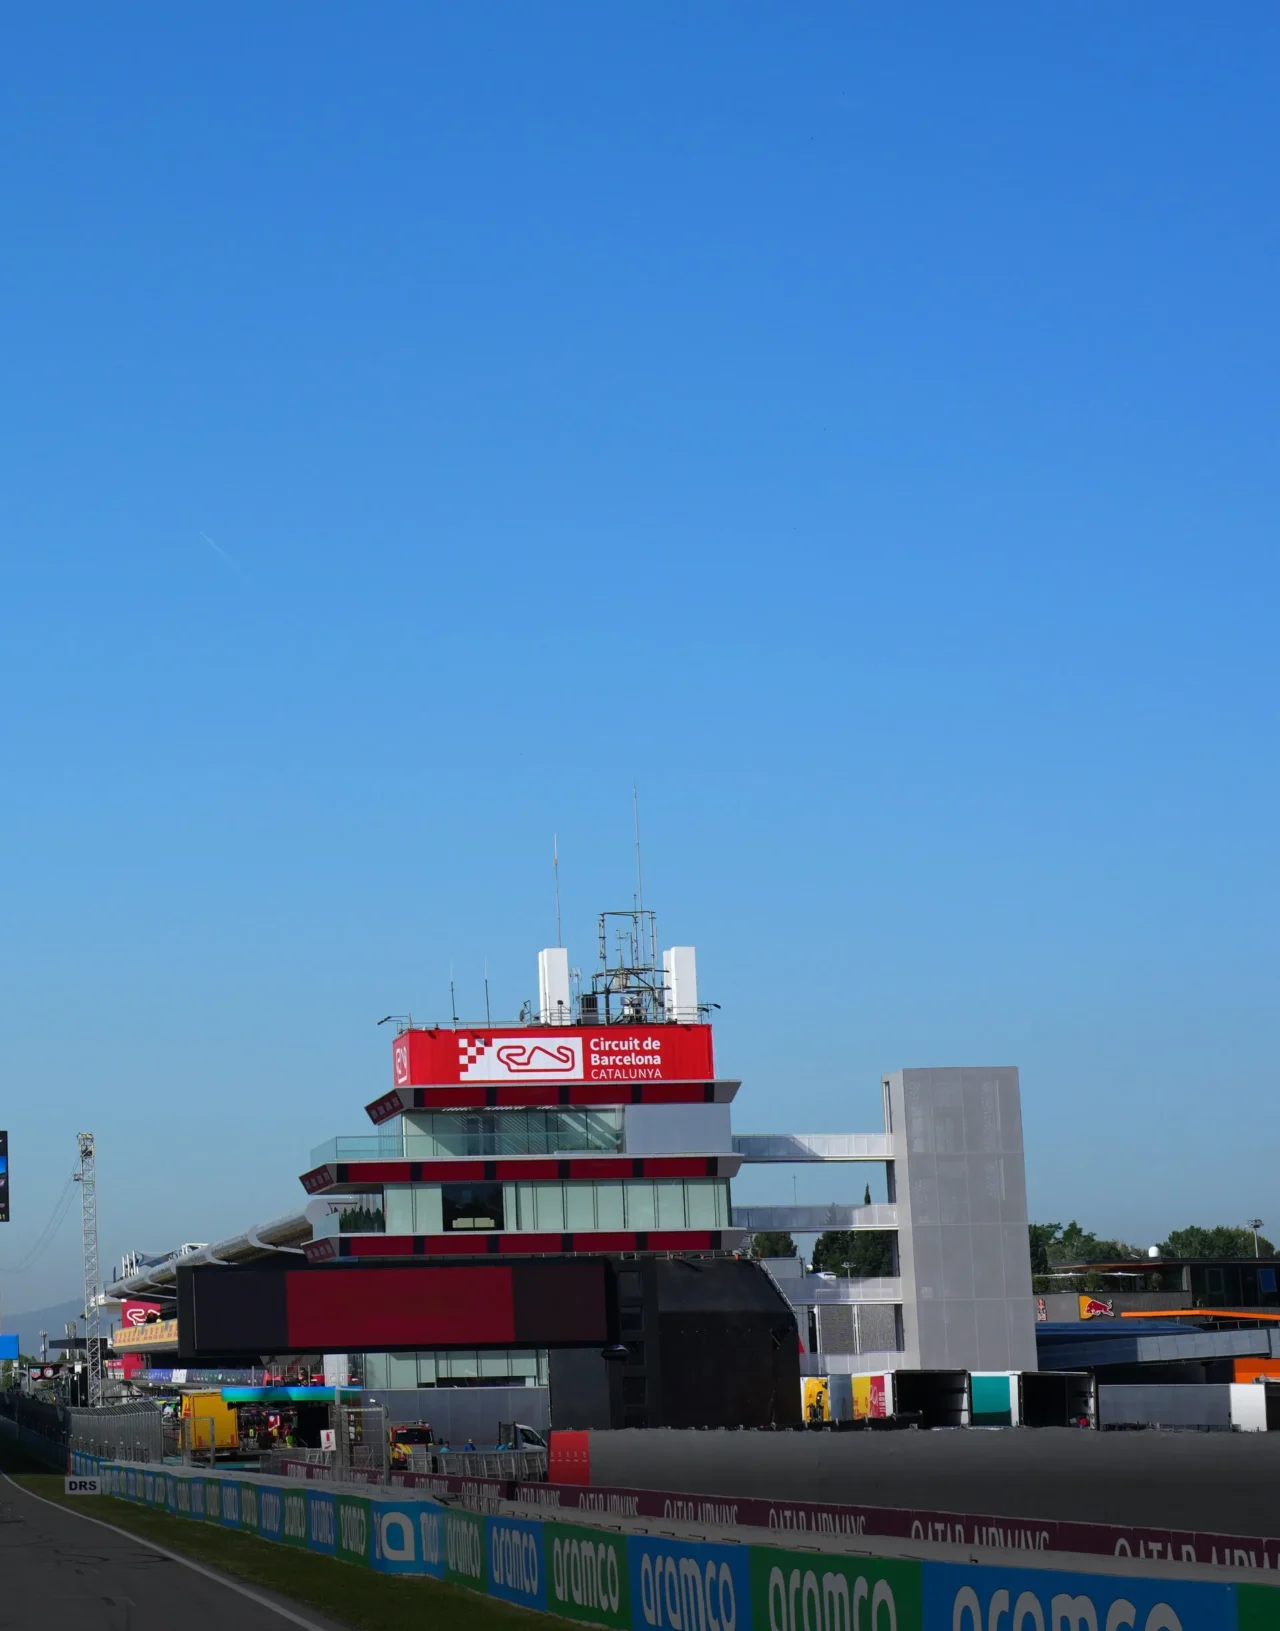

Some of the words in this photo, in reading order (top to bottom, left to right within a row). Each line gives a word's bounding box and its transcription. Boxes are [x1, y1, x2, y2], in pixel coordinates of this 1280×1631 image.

[590, 1037, 640, 1051] Circuit
[642, 1037, 661, 1051] de
[591, 1053, 661, 1066] Barcelona
[591, 1068, 662, 1080] CATALUNYA
[70, 1481, 97, 1491] DRS
[492, 1525, 538, 1596] aramco
[553, 1536, 619, 1614] aramco
[641, 1553, 736, 1631] aramco
